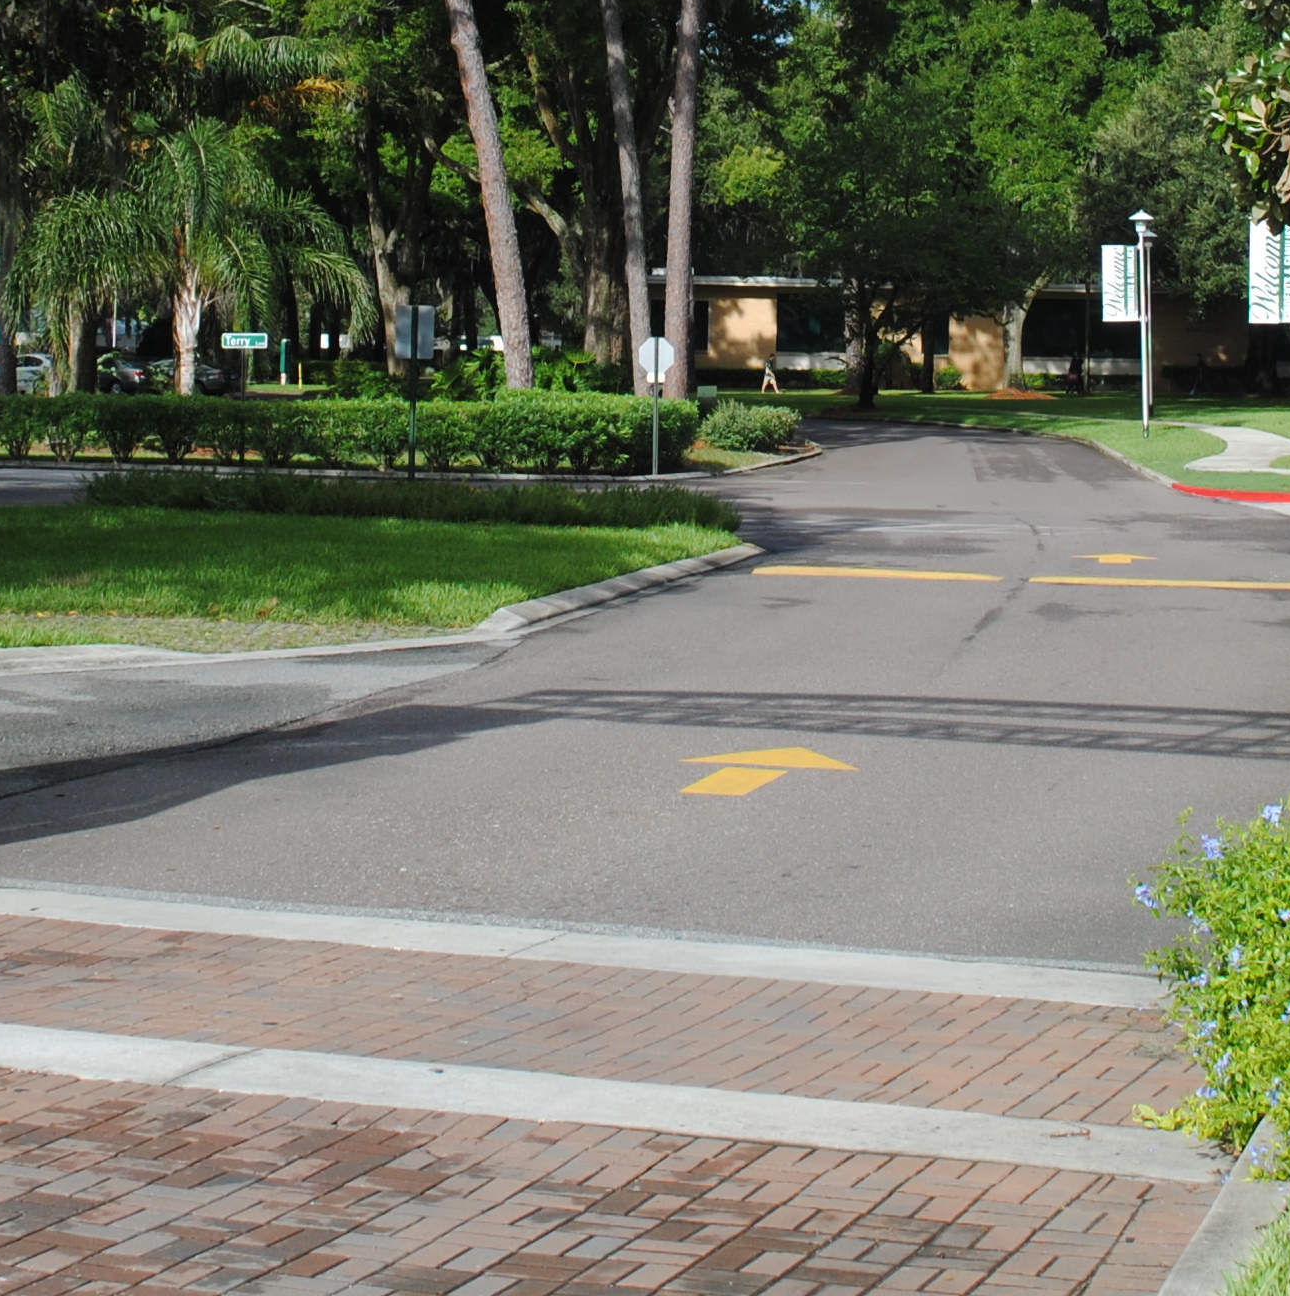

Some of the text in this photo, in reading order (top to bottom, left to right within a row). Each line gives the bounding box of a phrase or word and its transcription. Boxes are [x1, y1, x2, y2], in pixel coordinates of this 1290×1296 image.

[1104, 247, 1125, 317] Welcome
[1250, 226, 1280, 320] Welcom
[224, 335, 251, 348] Terry
